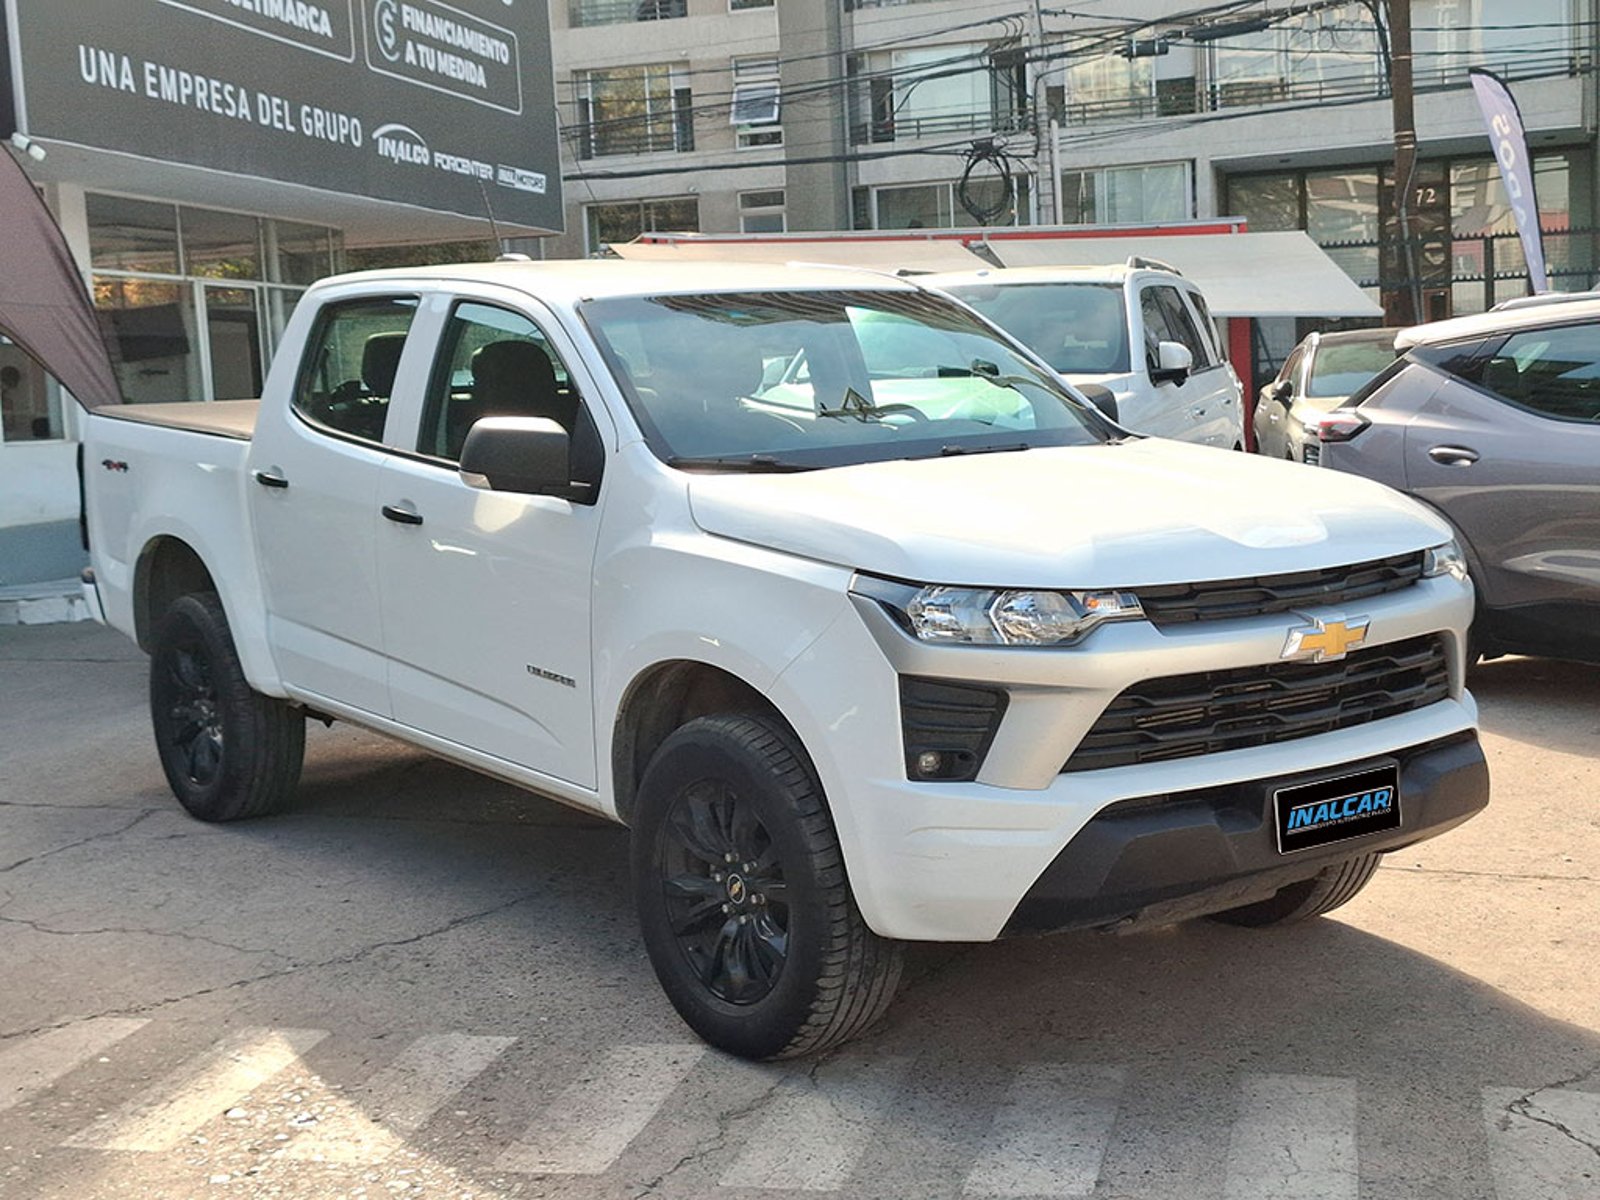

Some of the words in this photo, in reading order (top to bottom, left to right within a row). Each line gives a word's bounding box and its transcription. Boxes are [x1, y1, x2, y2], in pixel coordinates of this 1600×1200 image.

[226, 0, 333, 38] TIMARCA
[401, 4, 509, 65] FINANCIAMIENTO
[404, 40, 417, 66] A
[416, 43, 435, 71] TU
[437, 51, 487, 88] MEDIDA
[79, 44, 136, 93] UNA
[144, 61, 251, 122] EMPRESA
[257, 92, 296, 132] DEL
[300, 105, 362, 148] GRUPO
[378, 136, 430, 165] INALCO
[434, 151, 494, 181] FORCENTER
[1416, 188, 1436, 207] 72
